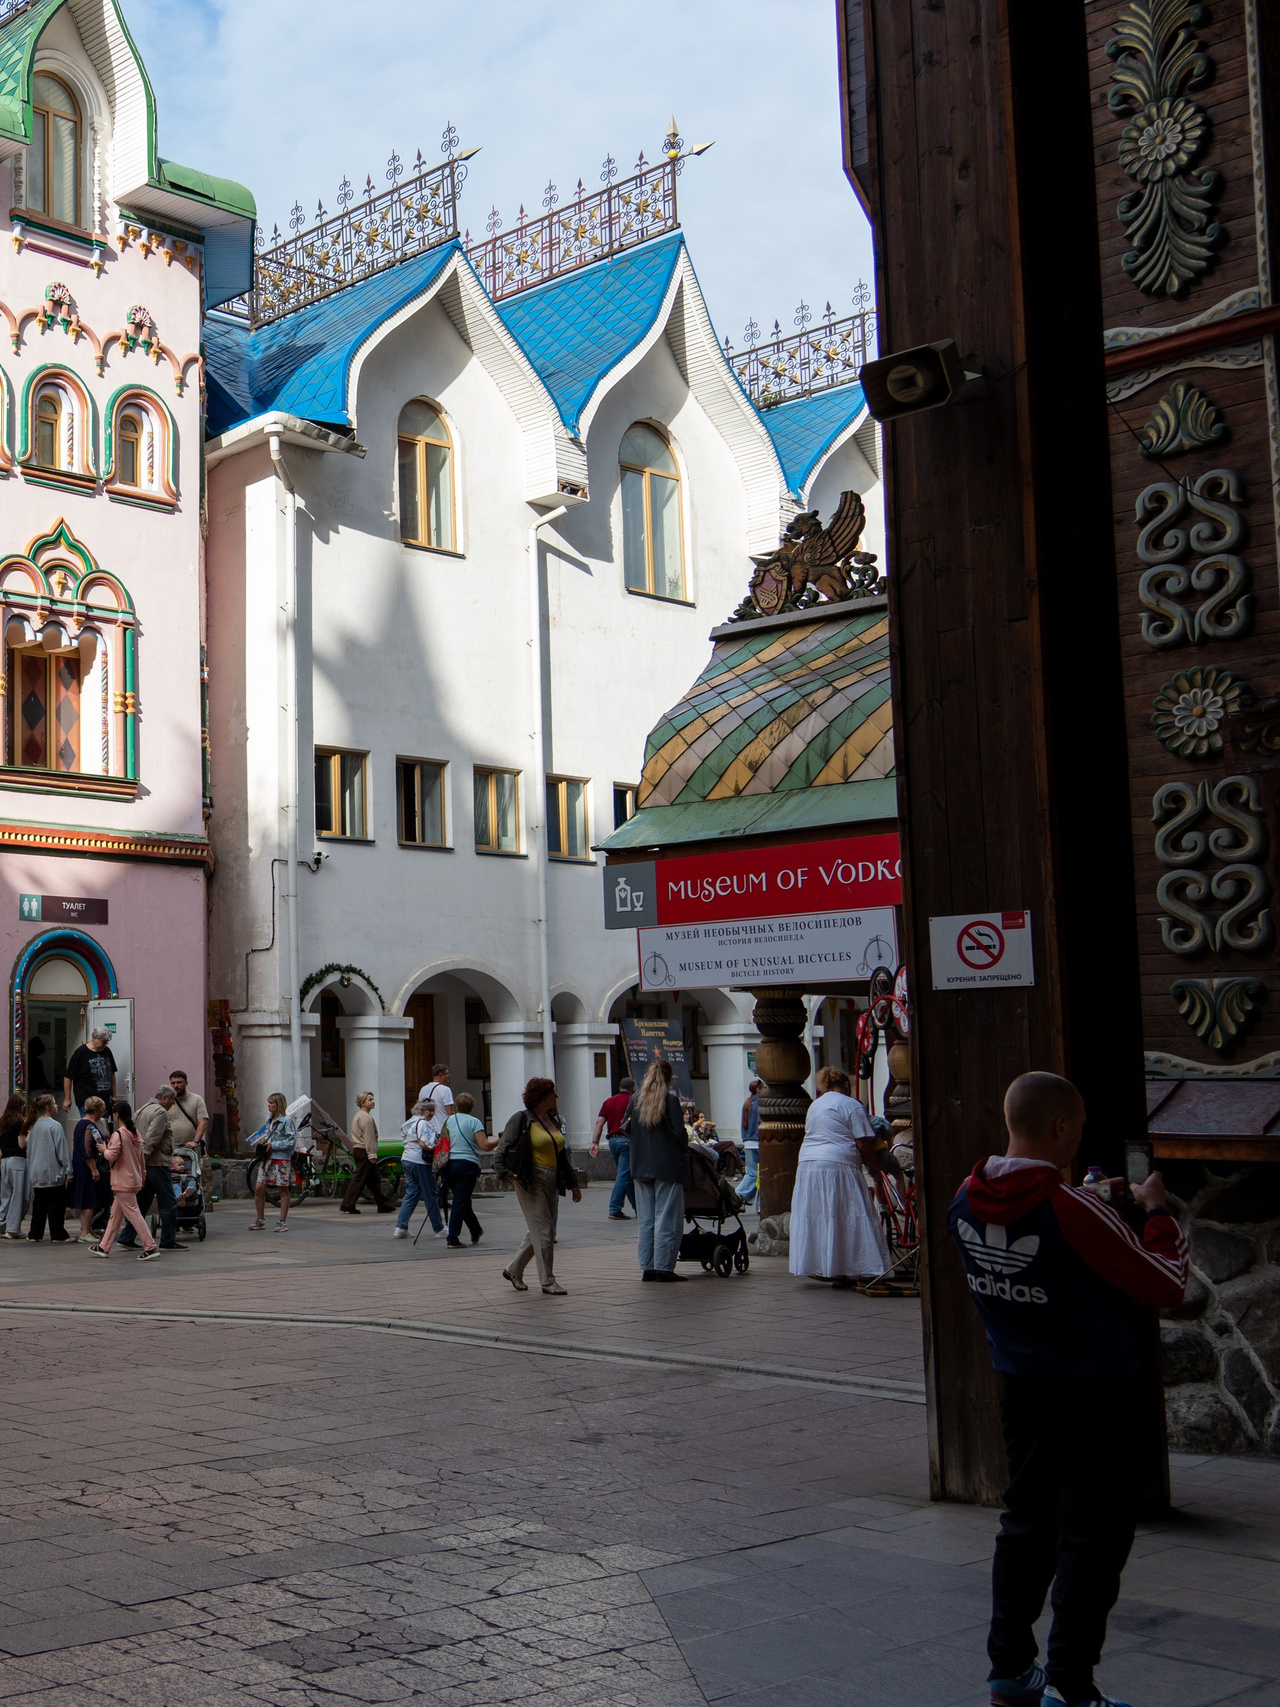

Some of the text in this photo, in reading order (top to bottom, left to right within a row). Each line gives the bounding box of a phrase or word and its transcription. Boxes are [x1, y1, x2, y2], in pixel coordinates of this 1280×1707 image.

[776, 868, 808, 890] OF
[62, 902, 86, 910] ТУАЛЕТ
[665, 918, 862, 941] МУЗЕЙ НЕОБЫЧНЫХ ВЕЛОСИПЕДОВ
[718, 934, 804, 946] ИСТОРИЯ ВЕЛОСИПЕДА
[678, 952, 852, 972] MUSEUM OF UNUSUAL BICYCLES
[731, 967, 795, 978] BICYCLE HISTORY
[978, 974, 1022, 982] ЗАПРЕЩЕНО
[633, 1019, 669, 1028] Кремлевские
[640, 1028, 665, 1037] Напитки
[967, 1273, 1048, 1304] adidas
